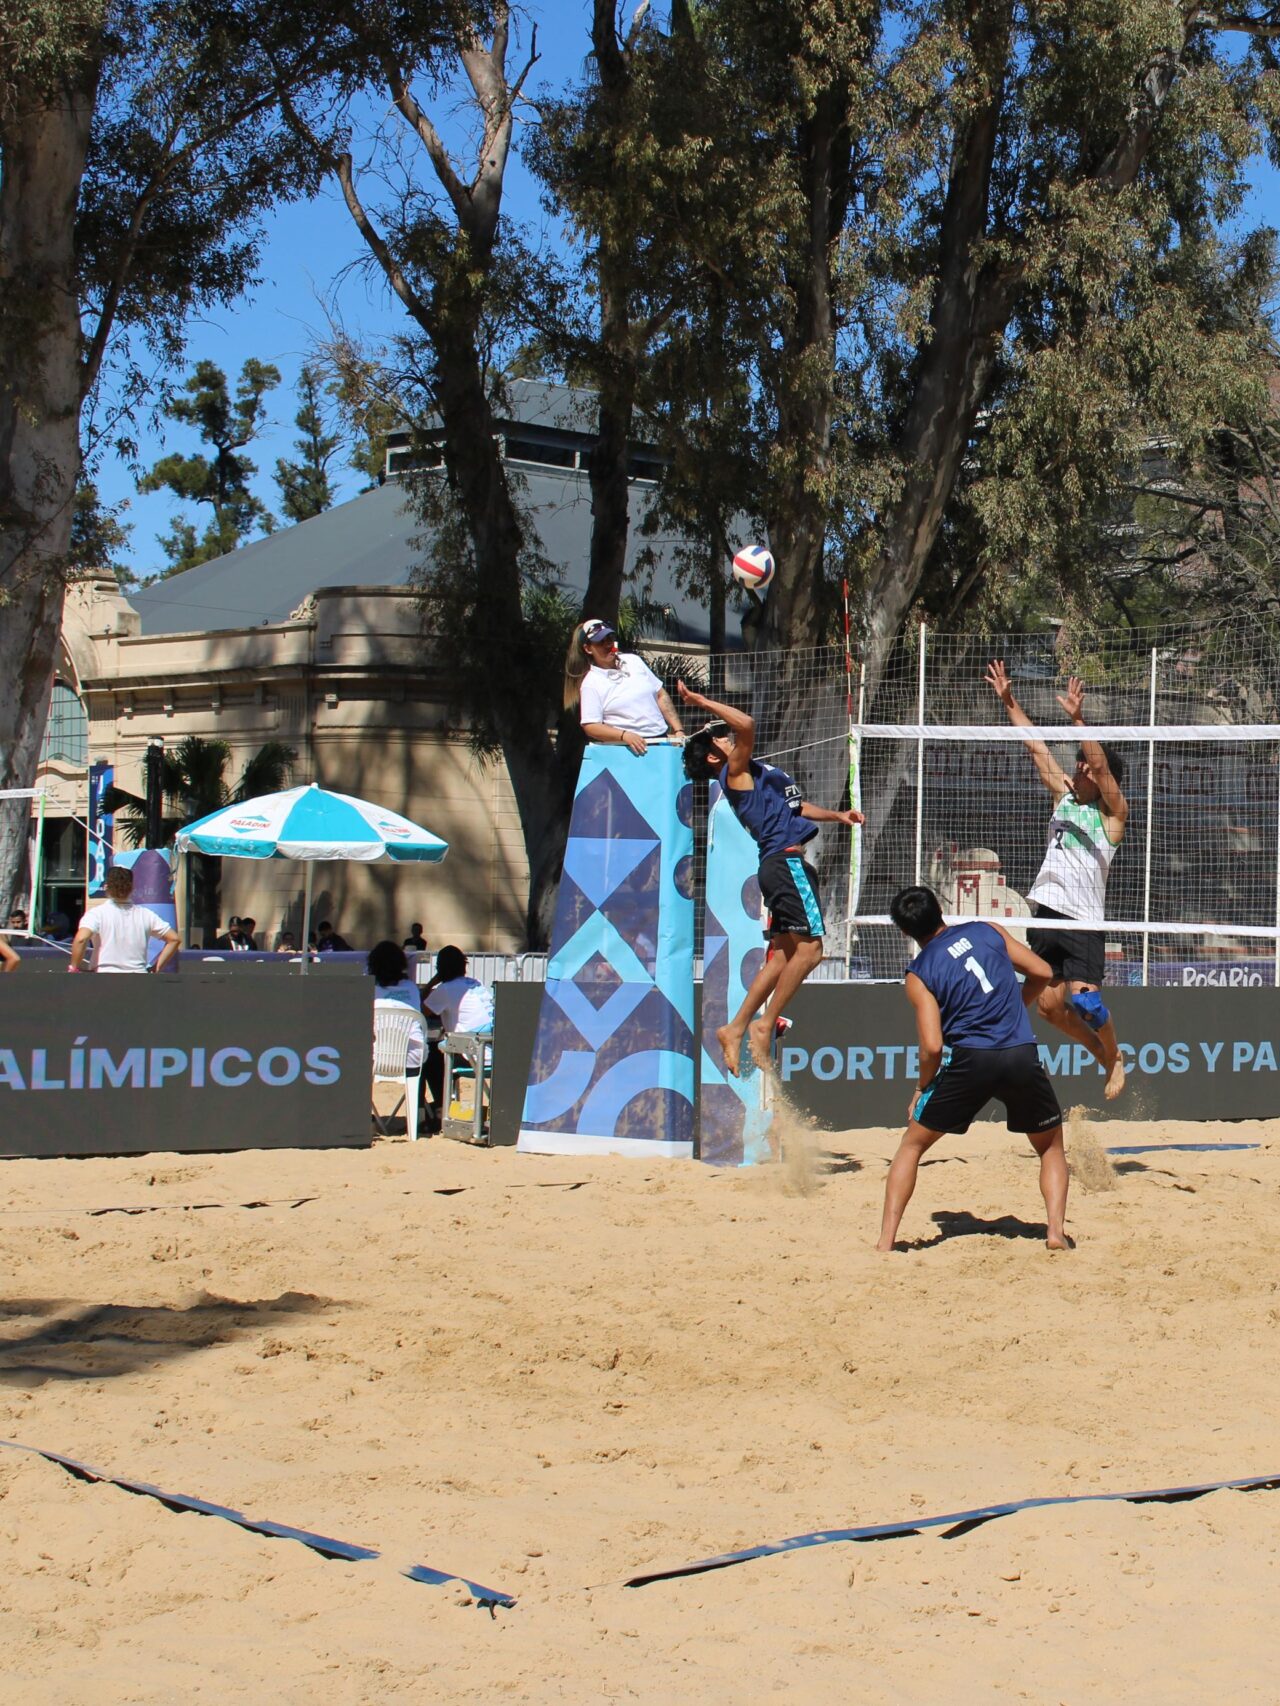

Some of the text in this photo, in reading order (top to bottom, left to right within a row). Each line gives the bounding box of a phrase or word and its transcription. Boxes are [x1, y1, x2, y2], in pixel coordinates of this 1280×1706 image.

[947, 937, 973, 959] ARG
[964, 955, 994, 994] 1
[1199, 1042, 1225, 1073] Y
